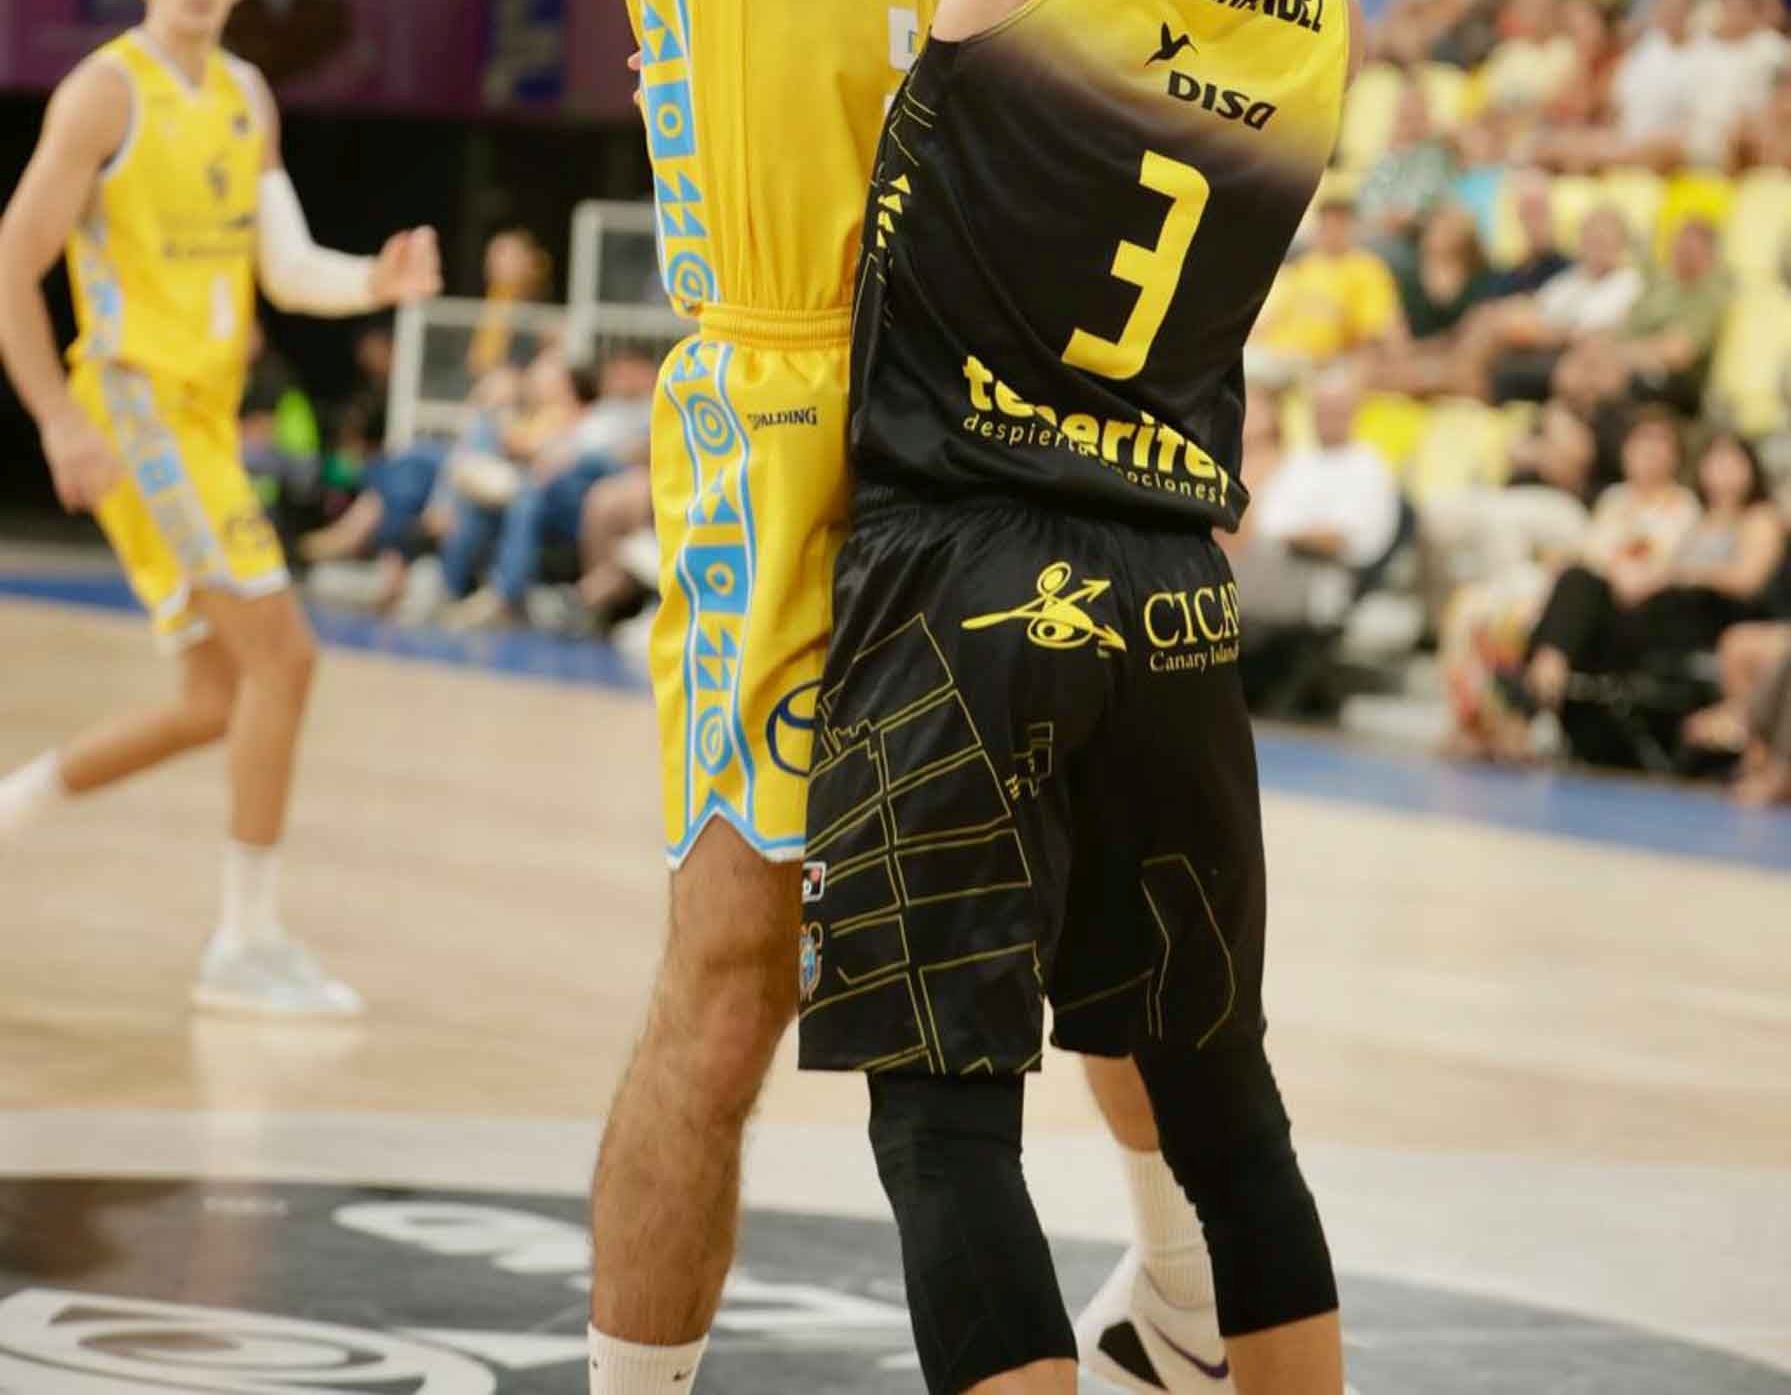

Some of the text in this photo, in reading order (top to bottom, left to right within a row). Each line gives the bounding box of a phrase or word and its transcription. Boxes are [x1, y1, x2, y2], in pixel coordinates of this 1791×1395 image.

[1061, 149, 1210, 380] 3
[1144, 581, 1239, 647] CICA
[1150, 651, 1207, 673] Canary
